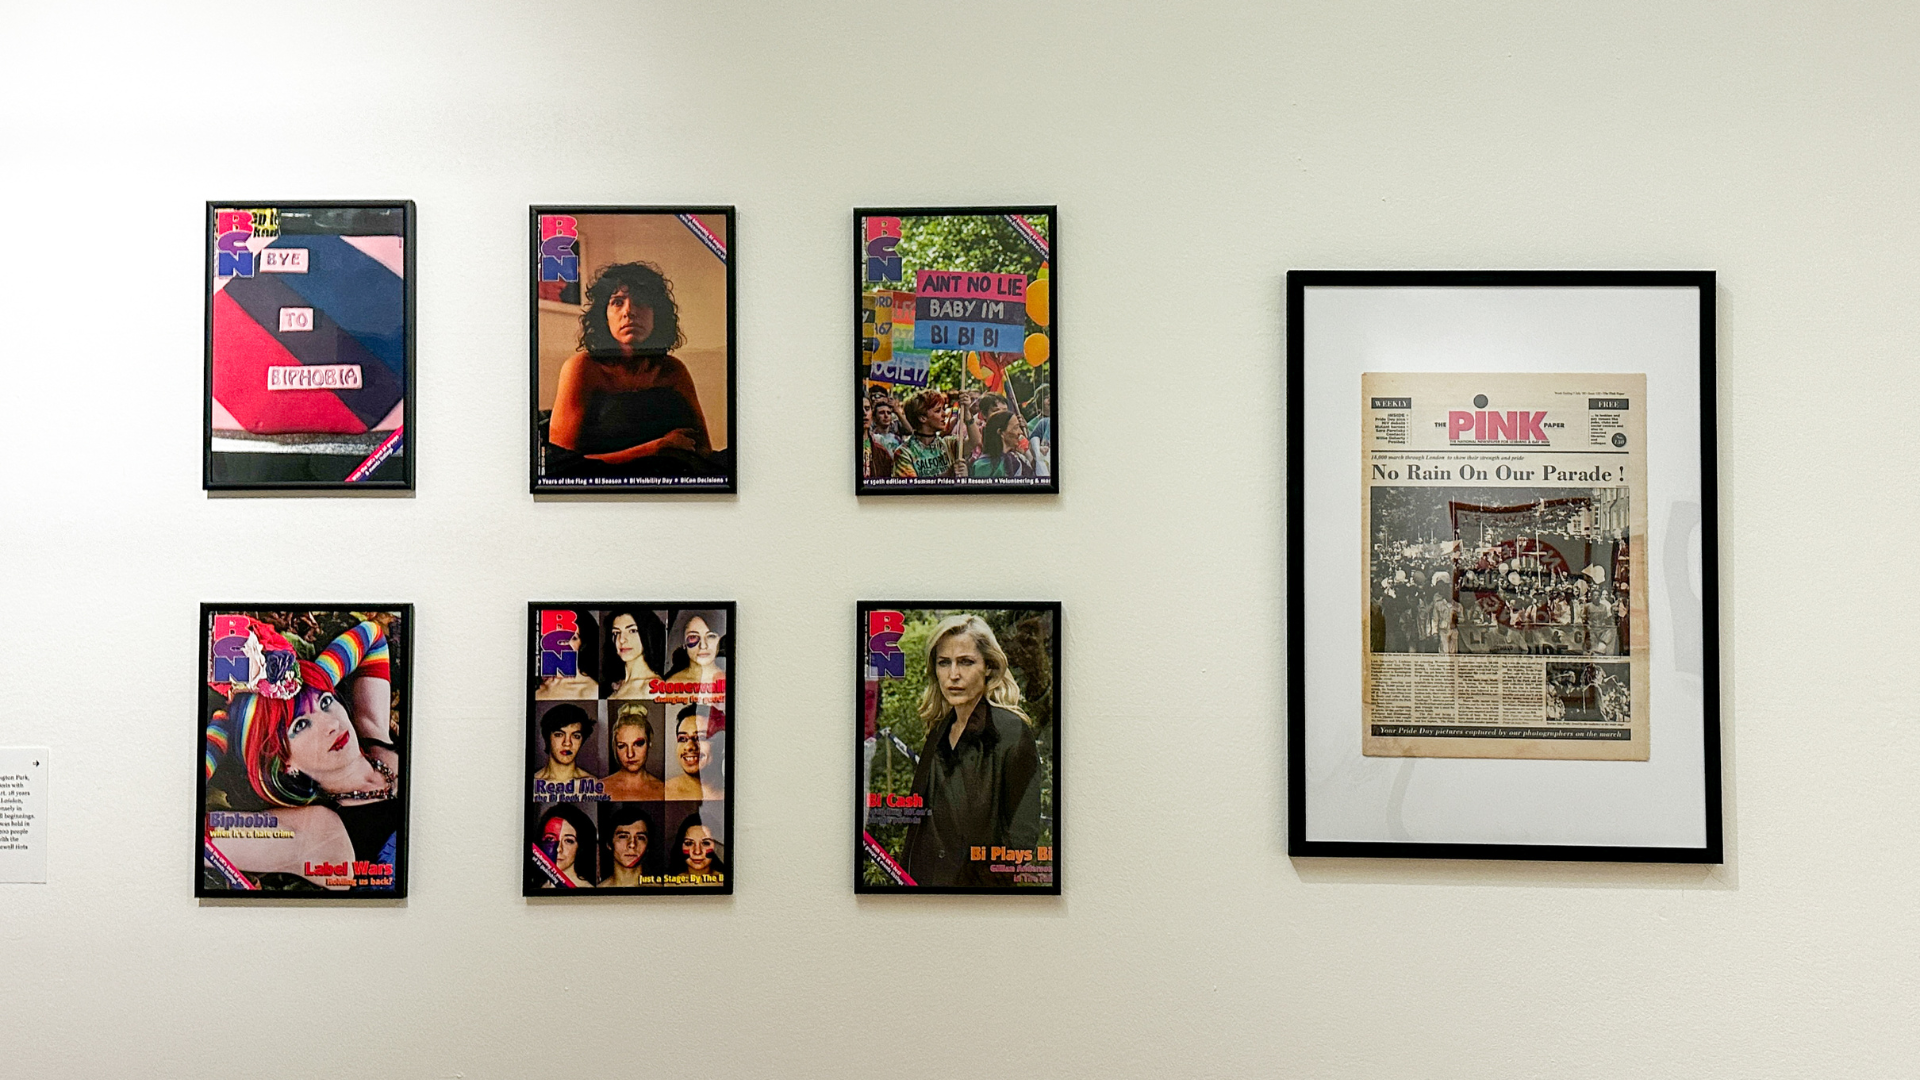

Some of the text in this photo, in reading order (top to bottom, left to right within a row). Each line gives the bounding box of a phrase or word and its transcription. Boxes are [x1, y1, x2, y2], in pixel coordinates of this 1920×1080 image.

[541, 215, 578, 282] BCN
[867, 216, 903, 282] BCN
[267, 252, 301, 266] BYE
[967, 275, 991, 292] NO
[997, 277, 1023, 296] LIE
[876, 296, 892, 308] RD
[929, 299, 976, 318] BABY
[286, 312, 308, 327] TO
[931, 325, 948, 344] BI
[958, 327, 975, 345] BI
[983, 328, 999, 348] BI
[271, 368, 358, 386] BIPHOBIA
[870, 357, 929, 382] OCIETY
[1372, 464, 1624, 482] No Rain On Our Parade !
[213, 614, 250, 683] BCN
[540, 610, 578, 677] BCN
[869, 611, 905, 677] BCN
[1435, 728, 1463, 736] pictures
[1523, 729, 1573, 737] photographers
[535, 778, 604, 794] Read Me
[866, 793, 924, 808] Bi Cash
[209, 811, 278, 830] Biphobia
[209, 830, 232, 839] when
[254, 830, 271, 839] hate
[273, 830, 295, 839] crime
[970, 846, 986, 861] Bi
[991, 846, 1033, 864] Plays
[304, 860, 393, 876] Label Wars
[370, 877, 393, 886] back?
[639, 875, 655, 885] Just
[690, 874, 702, 884] By
[703, 874, 717, 883] The
